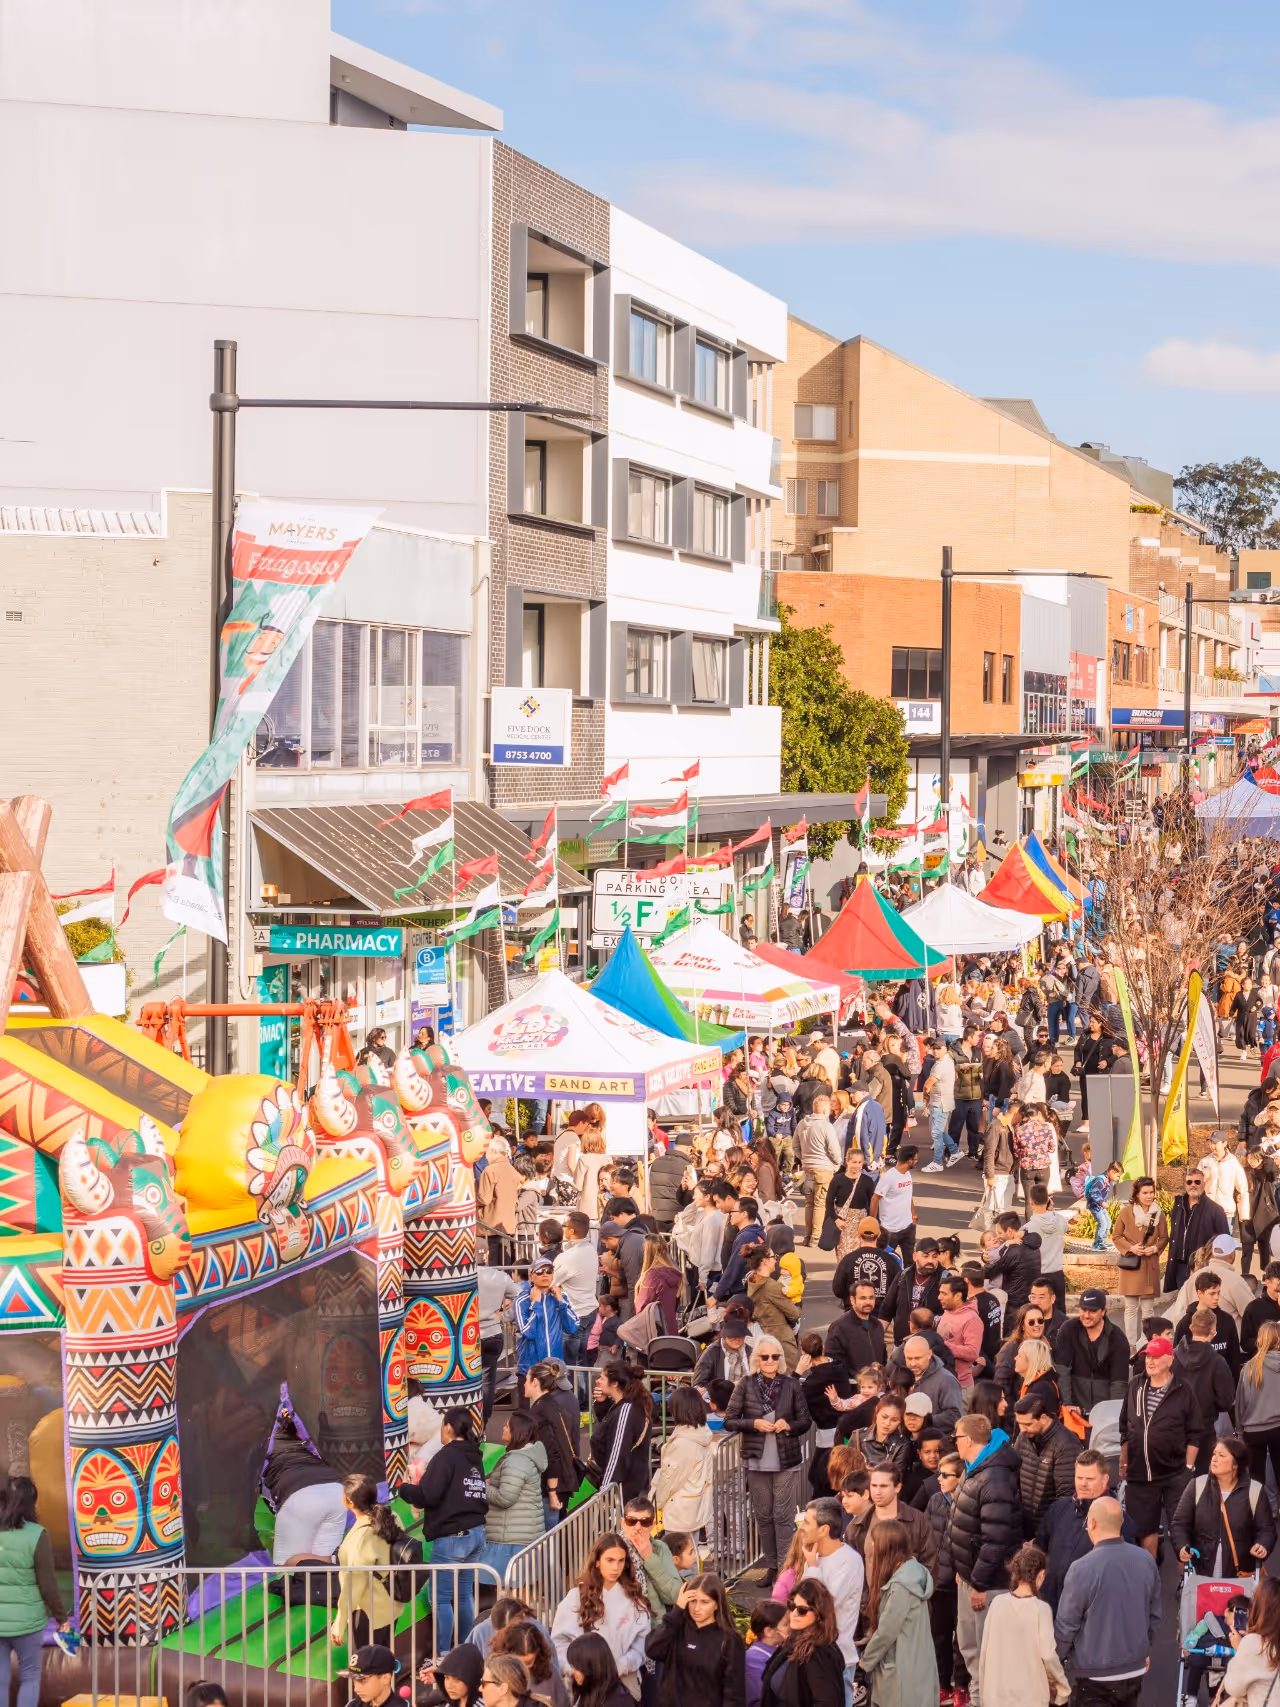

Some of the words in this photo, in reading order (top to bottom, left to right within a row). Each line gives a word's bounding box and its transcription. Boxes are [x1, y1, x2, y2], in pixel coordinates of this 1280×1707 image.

[268, 521, 338, 541] MAYERS
[911, 707, 931, 718] 144
[1131, 709, 1164, 717] BURSON
[507, 725, 526, 733] FIVE
[527, 725, 551, 734] DOCK
[505, 750, 528, 759] 8753
[529, 751, 552, 760] 4700
[1102, 752, 1119, 762] Vet
[606, 883, 666, 894] PARKING
[296, 932, 399, 952] PHARMACY
[411, 931, 433, 947] CENTRE
[423, 953, 431, 963] B
[549, 1078, 592, 1091] SAND
[598, 1081, 629, 1093] ART
[862, 1252, 878, 1260] your
